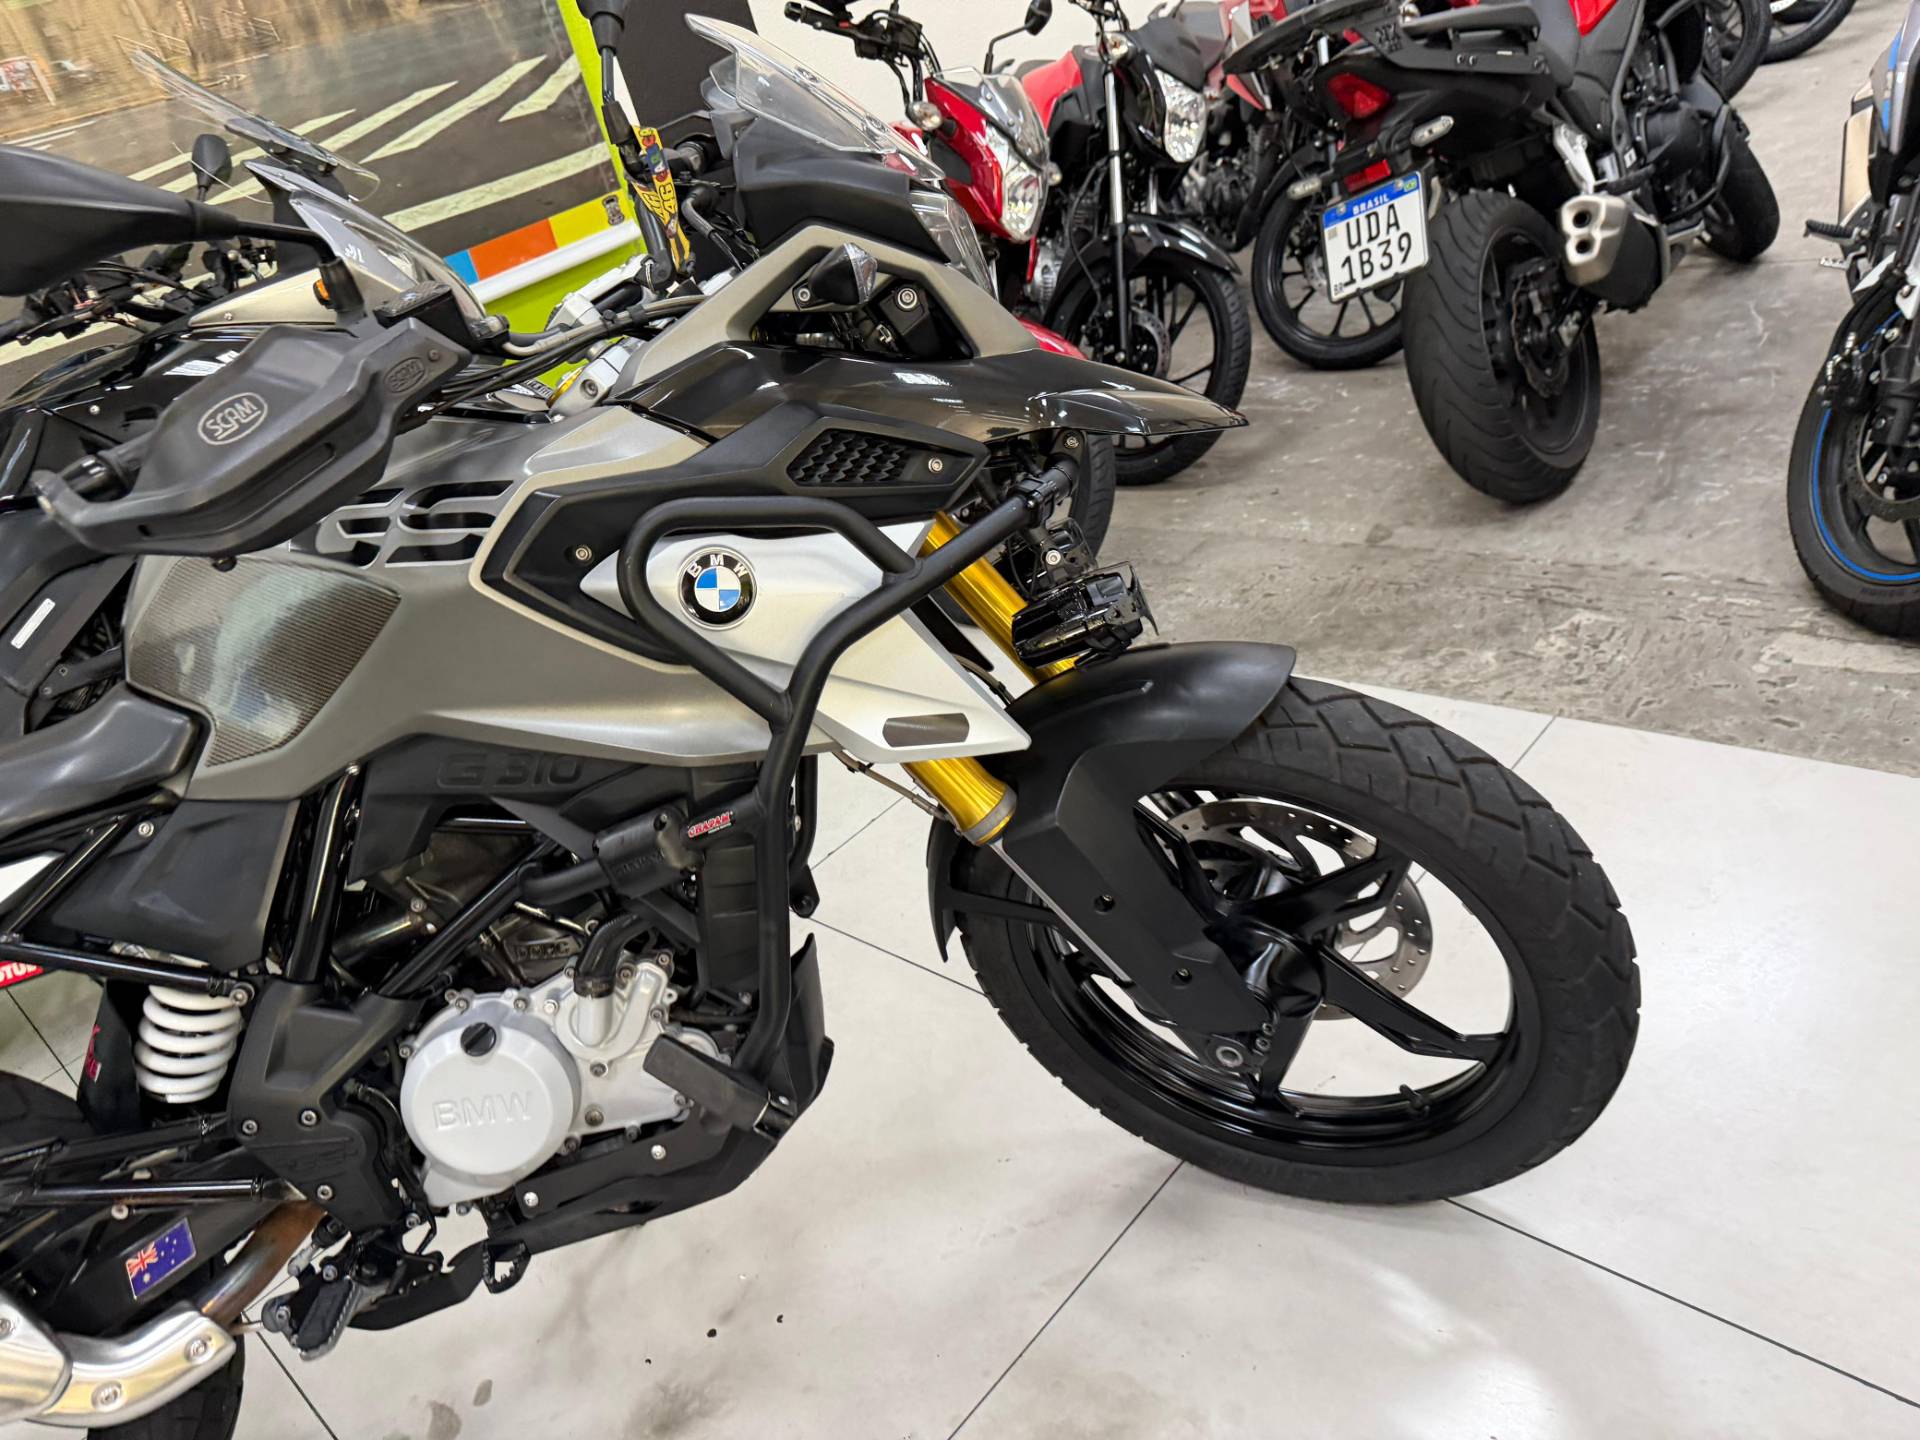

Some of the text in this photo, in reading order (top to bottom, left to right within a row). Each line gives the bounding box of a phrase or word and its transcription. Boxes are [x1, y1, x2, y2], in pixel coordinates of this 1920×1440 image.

[1352, 193, 1390, 216] BRASIL
[1346, 204, 1400, 250] UDA
[1341, 232, 1412, 287] 1B39
[387, 360, 425, 392] SCAM
[205, 397, 262, 441] SCAM
[687, 554, 748, 578] BMW
[493, 751, 585, 787] 310
[431, 1091, 534, 1131] BMW
